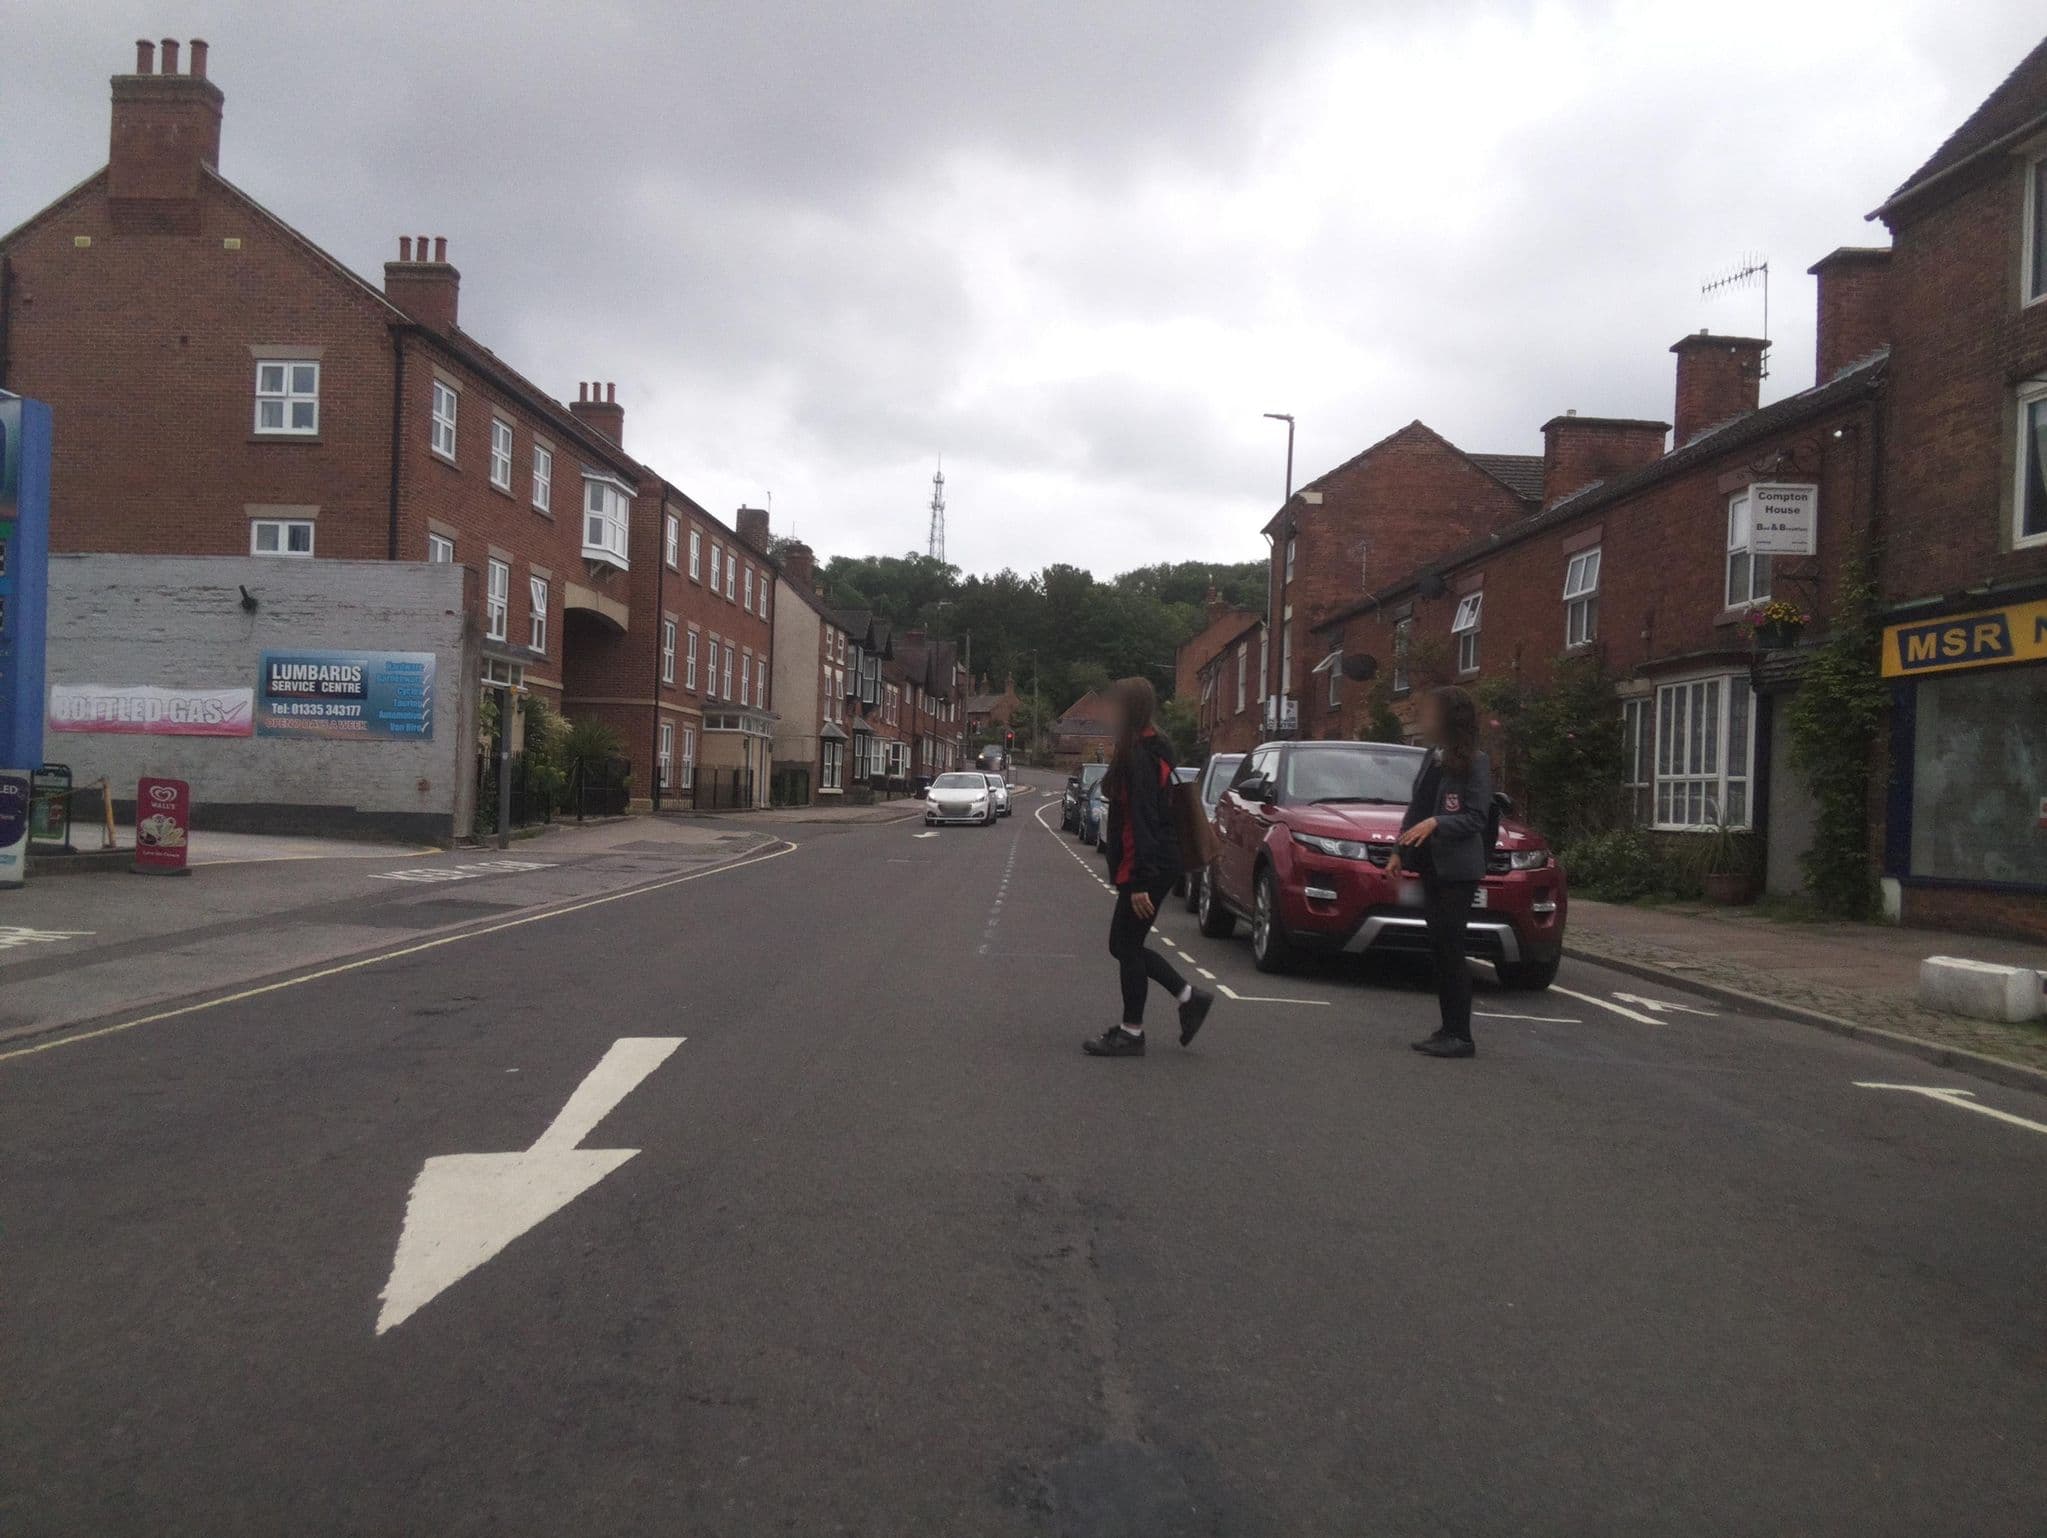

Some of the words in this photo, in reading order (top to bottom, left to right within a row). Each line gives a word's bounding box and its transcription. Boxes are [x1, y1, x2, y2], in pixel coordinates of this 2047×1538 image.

[1758, 492, 1808, 502] Compton
[1765, 505, 1800, 514] House
[1907, 623, 2002, 662] MSR
[272, 663, 362, 681] LUMBARDS
[272, 681, 316, 692] SERVICE
[321, 682, 361, 693] CENTRE
[56, 696, 162, 722] BOTTLED
[169, 698, 225, 724] GAS
[272, 703, 289, 715] Tel:
[292, 704, 326, 715] 01335
[326, 705, 361, 716] 343177
